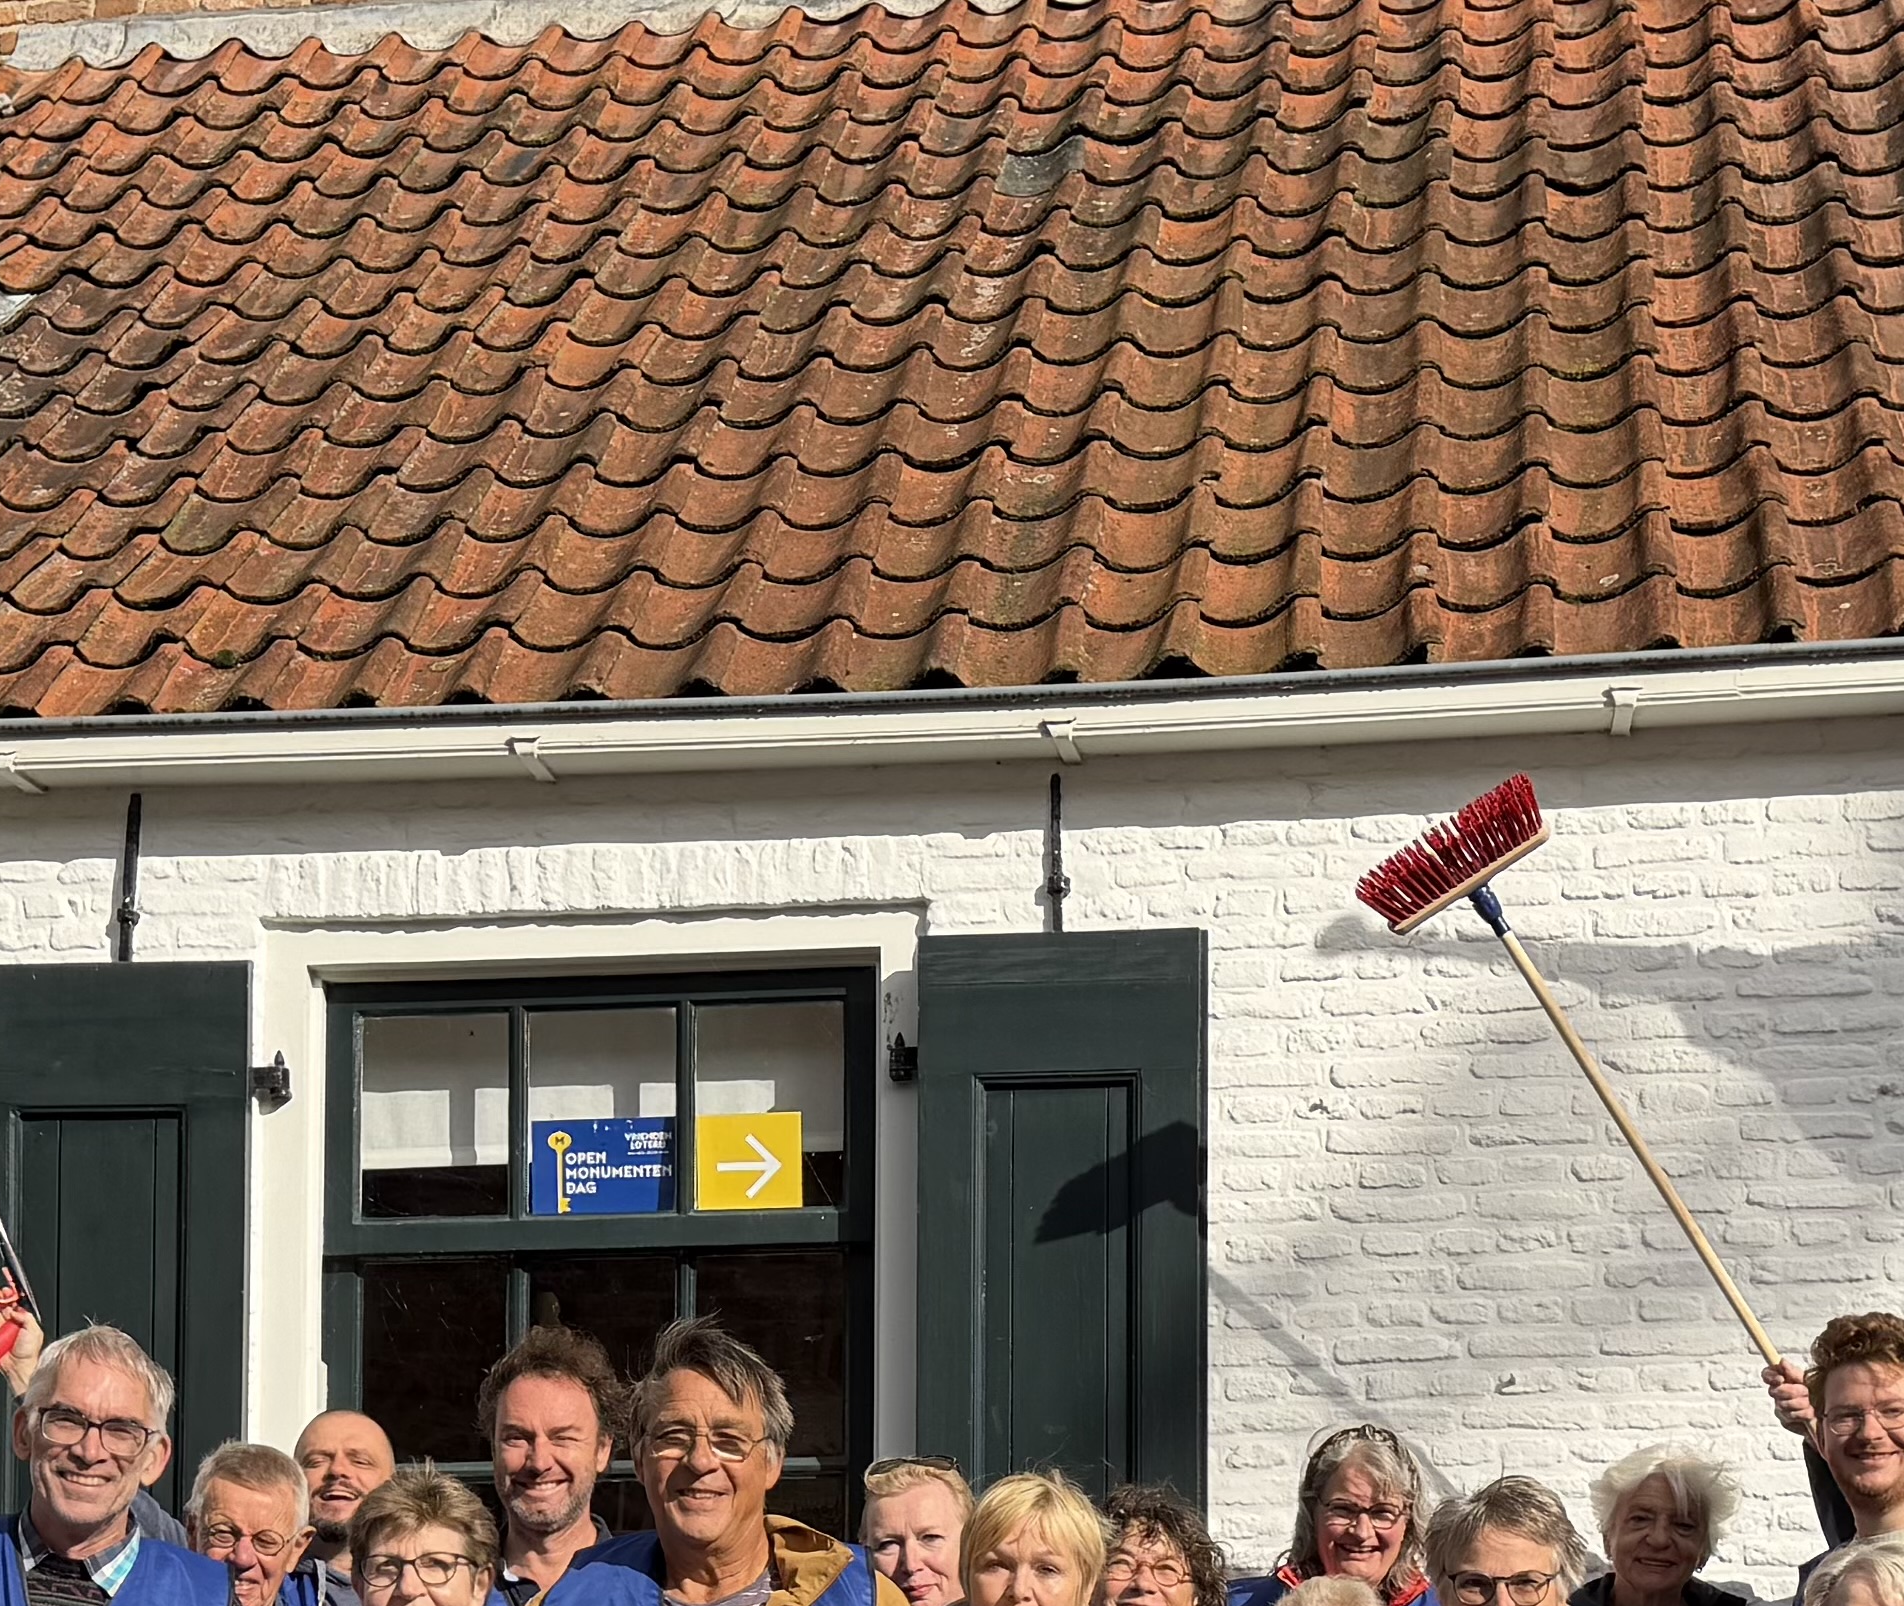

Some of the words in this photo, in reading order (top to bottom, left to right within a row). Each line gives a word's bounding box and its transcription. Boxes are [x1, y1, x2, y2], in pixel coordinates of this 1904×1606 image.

[565, 1151, 607, 1165] OPEN
[565, 1164, 673, 1180] MONUMENTEN
[565, 1181, 597, 1195] DAG
